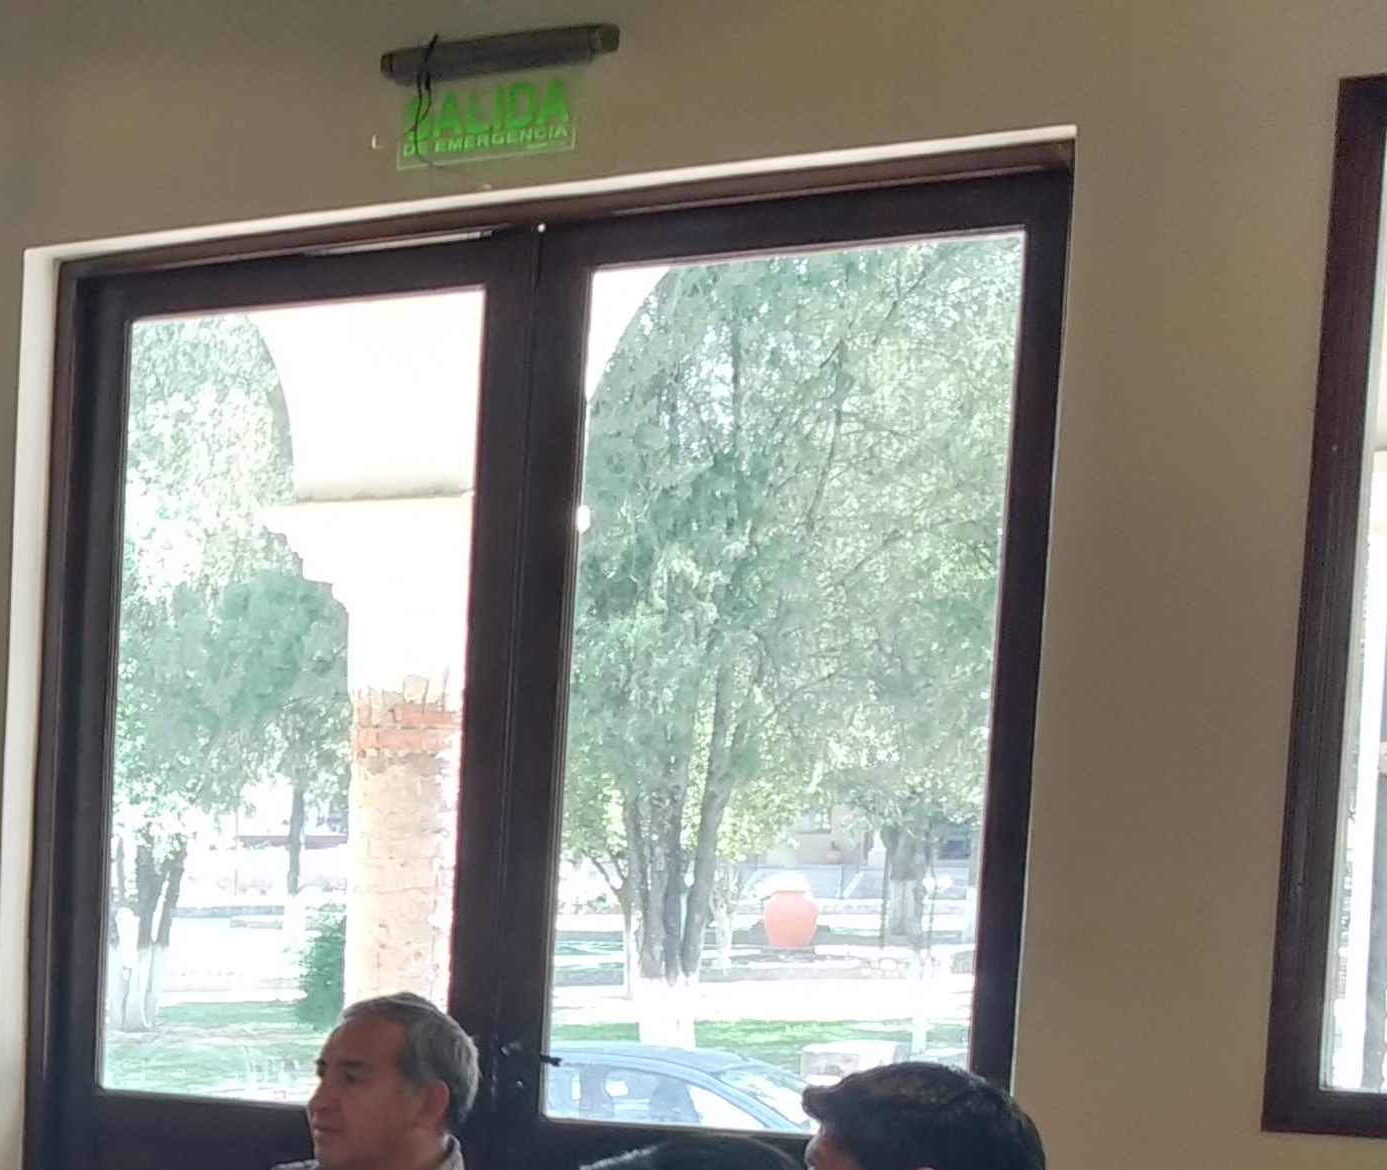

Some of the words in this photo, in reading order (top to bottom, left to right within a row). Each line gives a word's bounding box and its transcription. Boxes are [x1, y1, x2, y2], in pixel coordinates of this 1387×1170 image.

[406, 75, 570, 142] SALIDA
[402, 141, 428, 158] DE
[434, 124, 569, 153] EMERGENCIA
